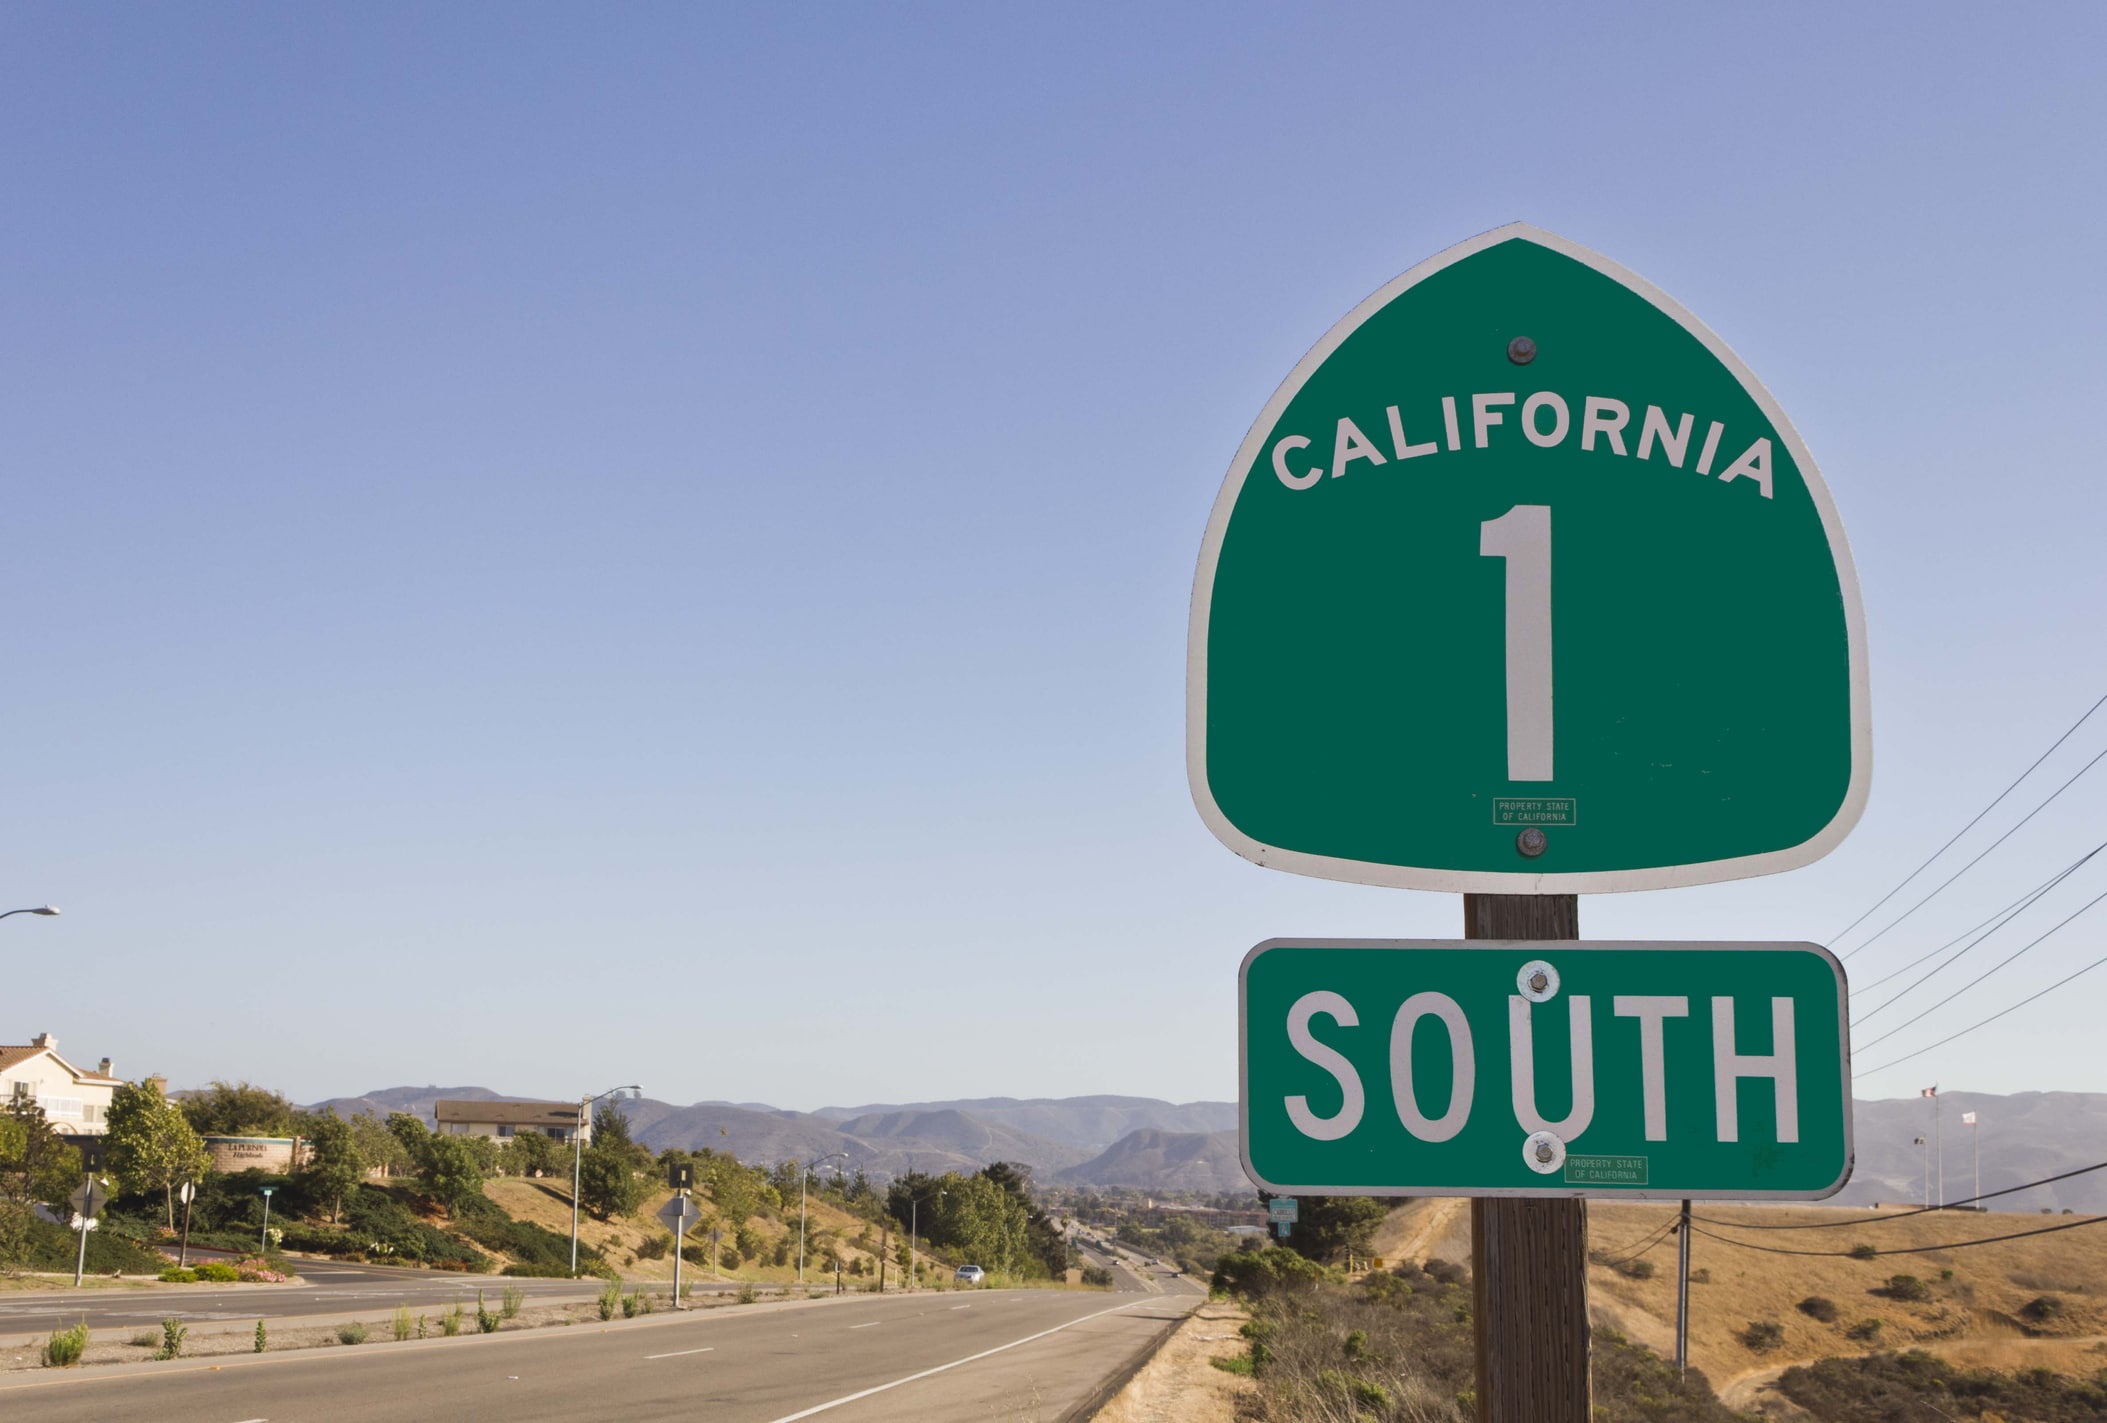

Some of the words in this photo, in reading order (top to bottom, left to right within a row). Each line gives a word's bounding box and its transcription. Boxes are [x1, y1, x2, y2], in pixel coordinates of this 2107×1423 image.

[1271, 391, 1774, 500] CALIFORNIA
[1479, 504, 1554, 782] 1
[1499, 802, 1542, 811] PROPERTY
[1546, 802, 1570, 811] STATE
[1502, 812, 1514, 821] OF
[1518, 812, 1567, 821] CALIFORNIA
[1284, 990, 1799, 1143] SOUTH
[1570, 1158, 1612, 1168] PROPERTY
[1616, 1159, 1643, 1169] STATE
[1575, 1169, 1586, 1179] OF
[1589, 1169, 1638, 1180] CALIFORNIA
